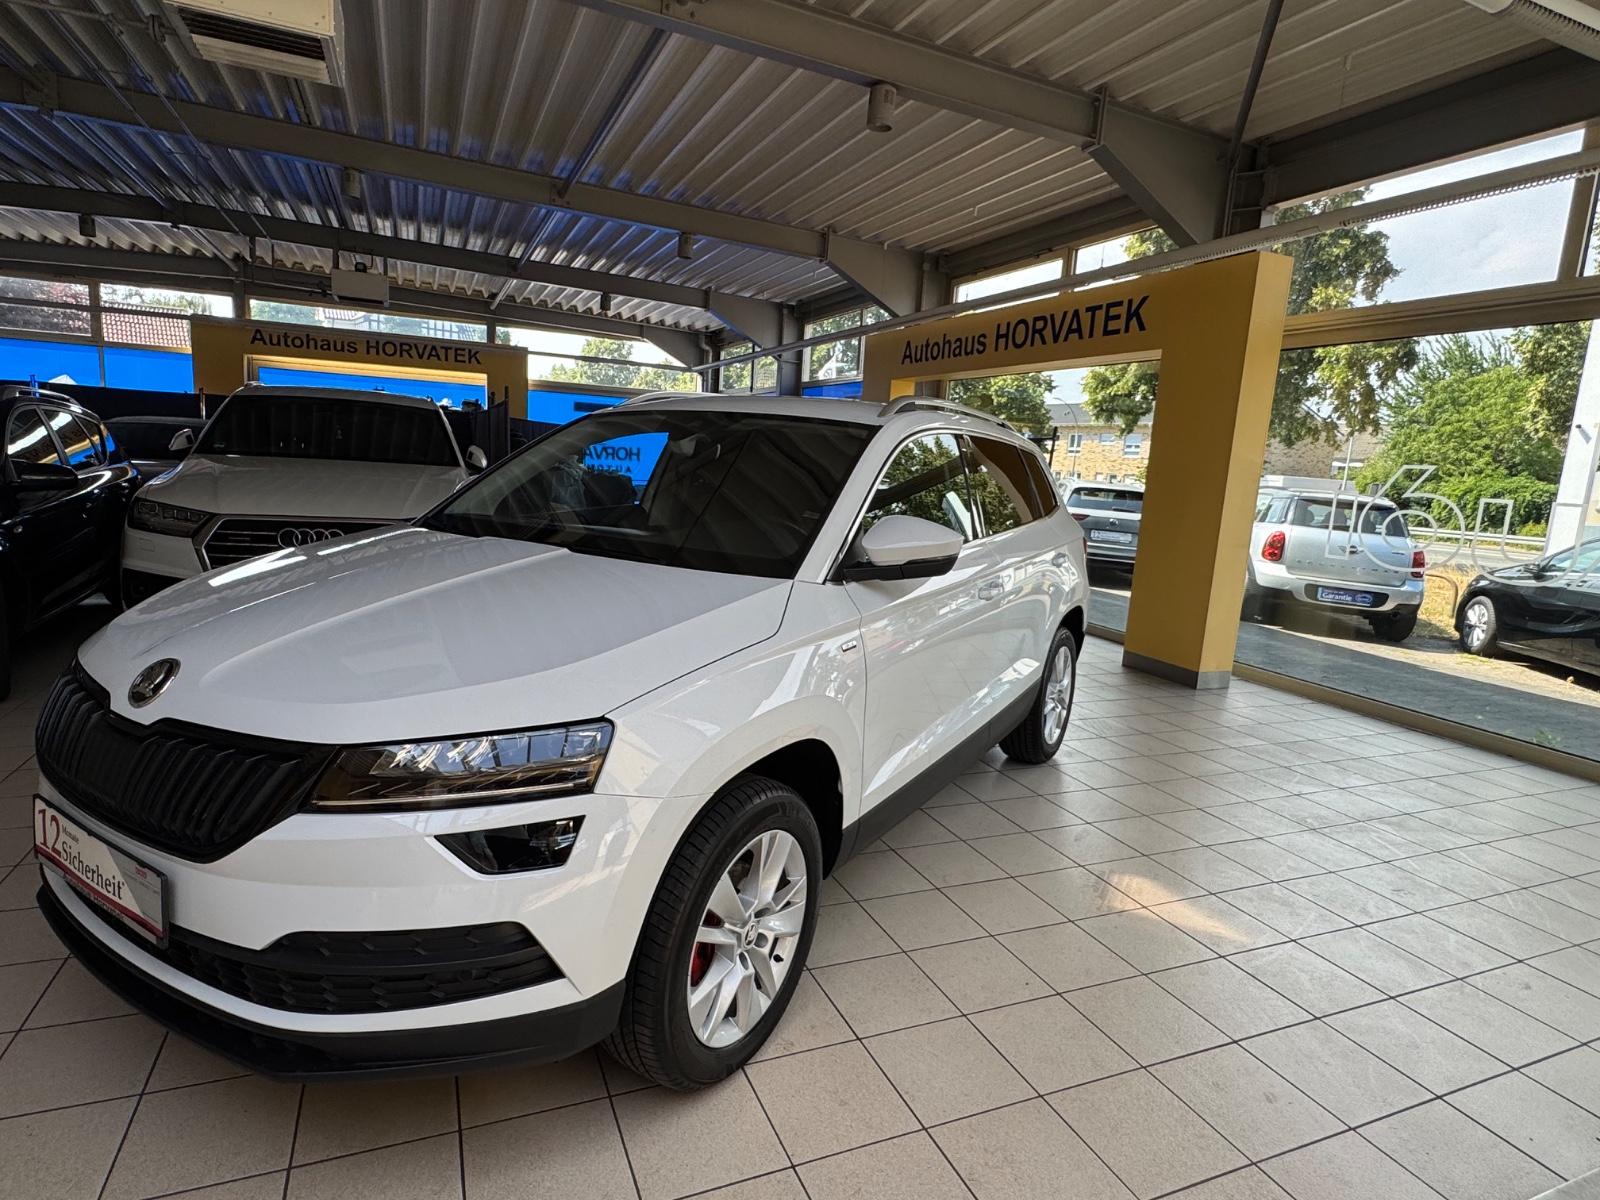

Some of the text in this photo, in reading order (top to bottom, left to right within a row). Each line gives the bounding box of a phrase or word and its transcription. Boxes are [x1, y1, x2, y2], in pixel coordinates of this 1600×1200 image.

[251, 328, 482, 365] Autohaus HORVATEK
[901, 295, 1150, 365] Autohaus HORVATEK
[38, 808, 62, 859] 12
[61, 841, 123, 900] Sicherheit
